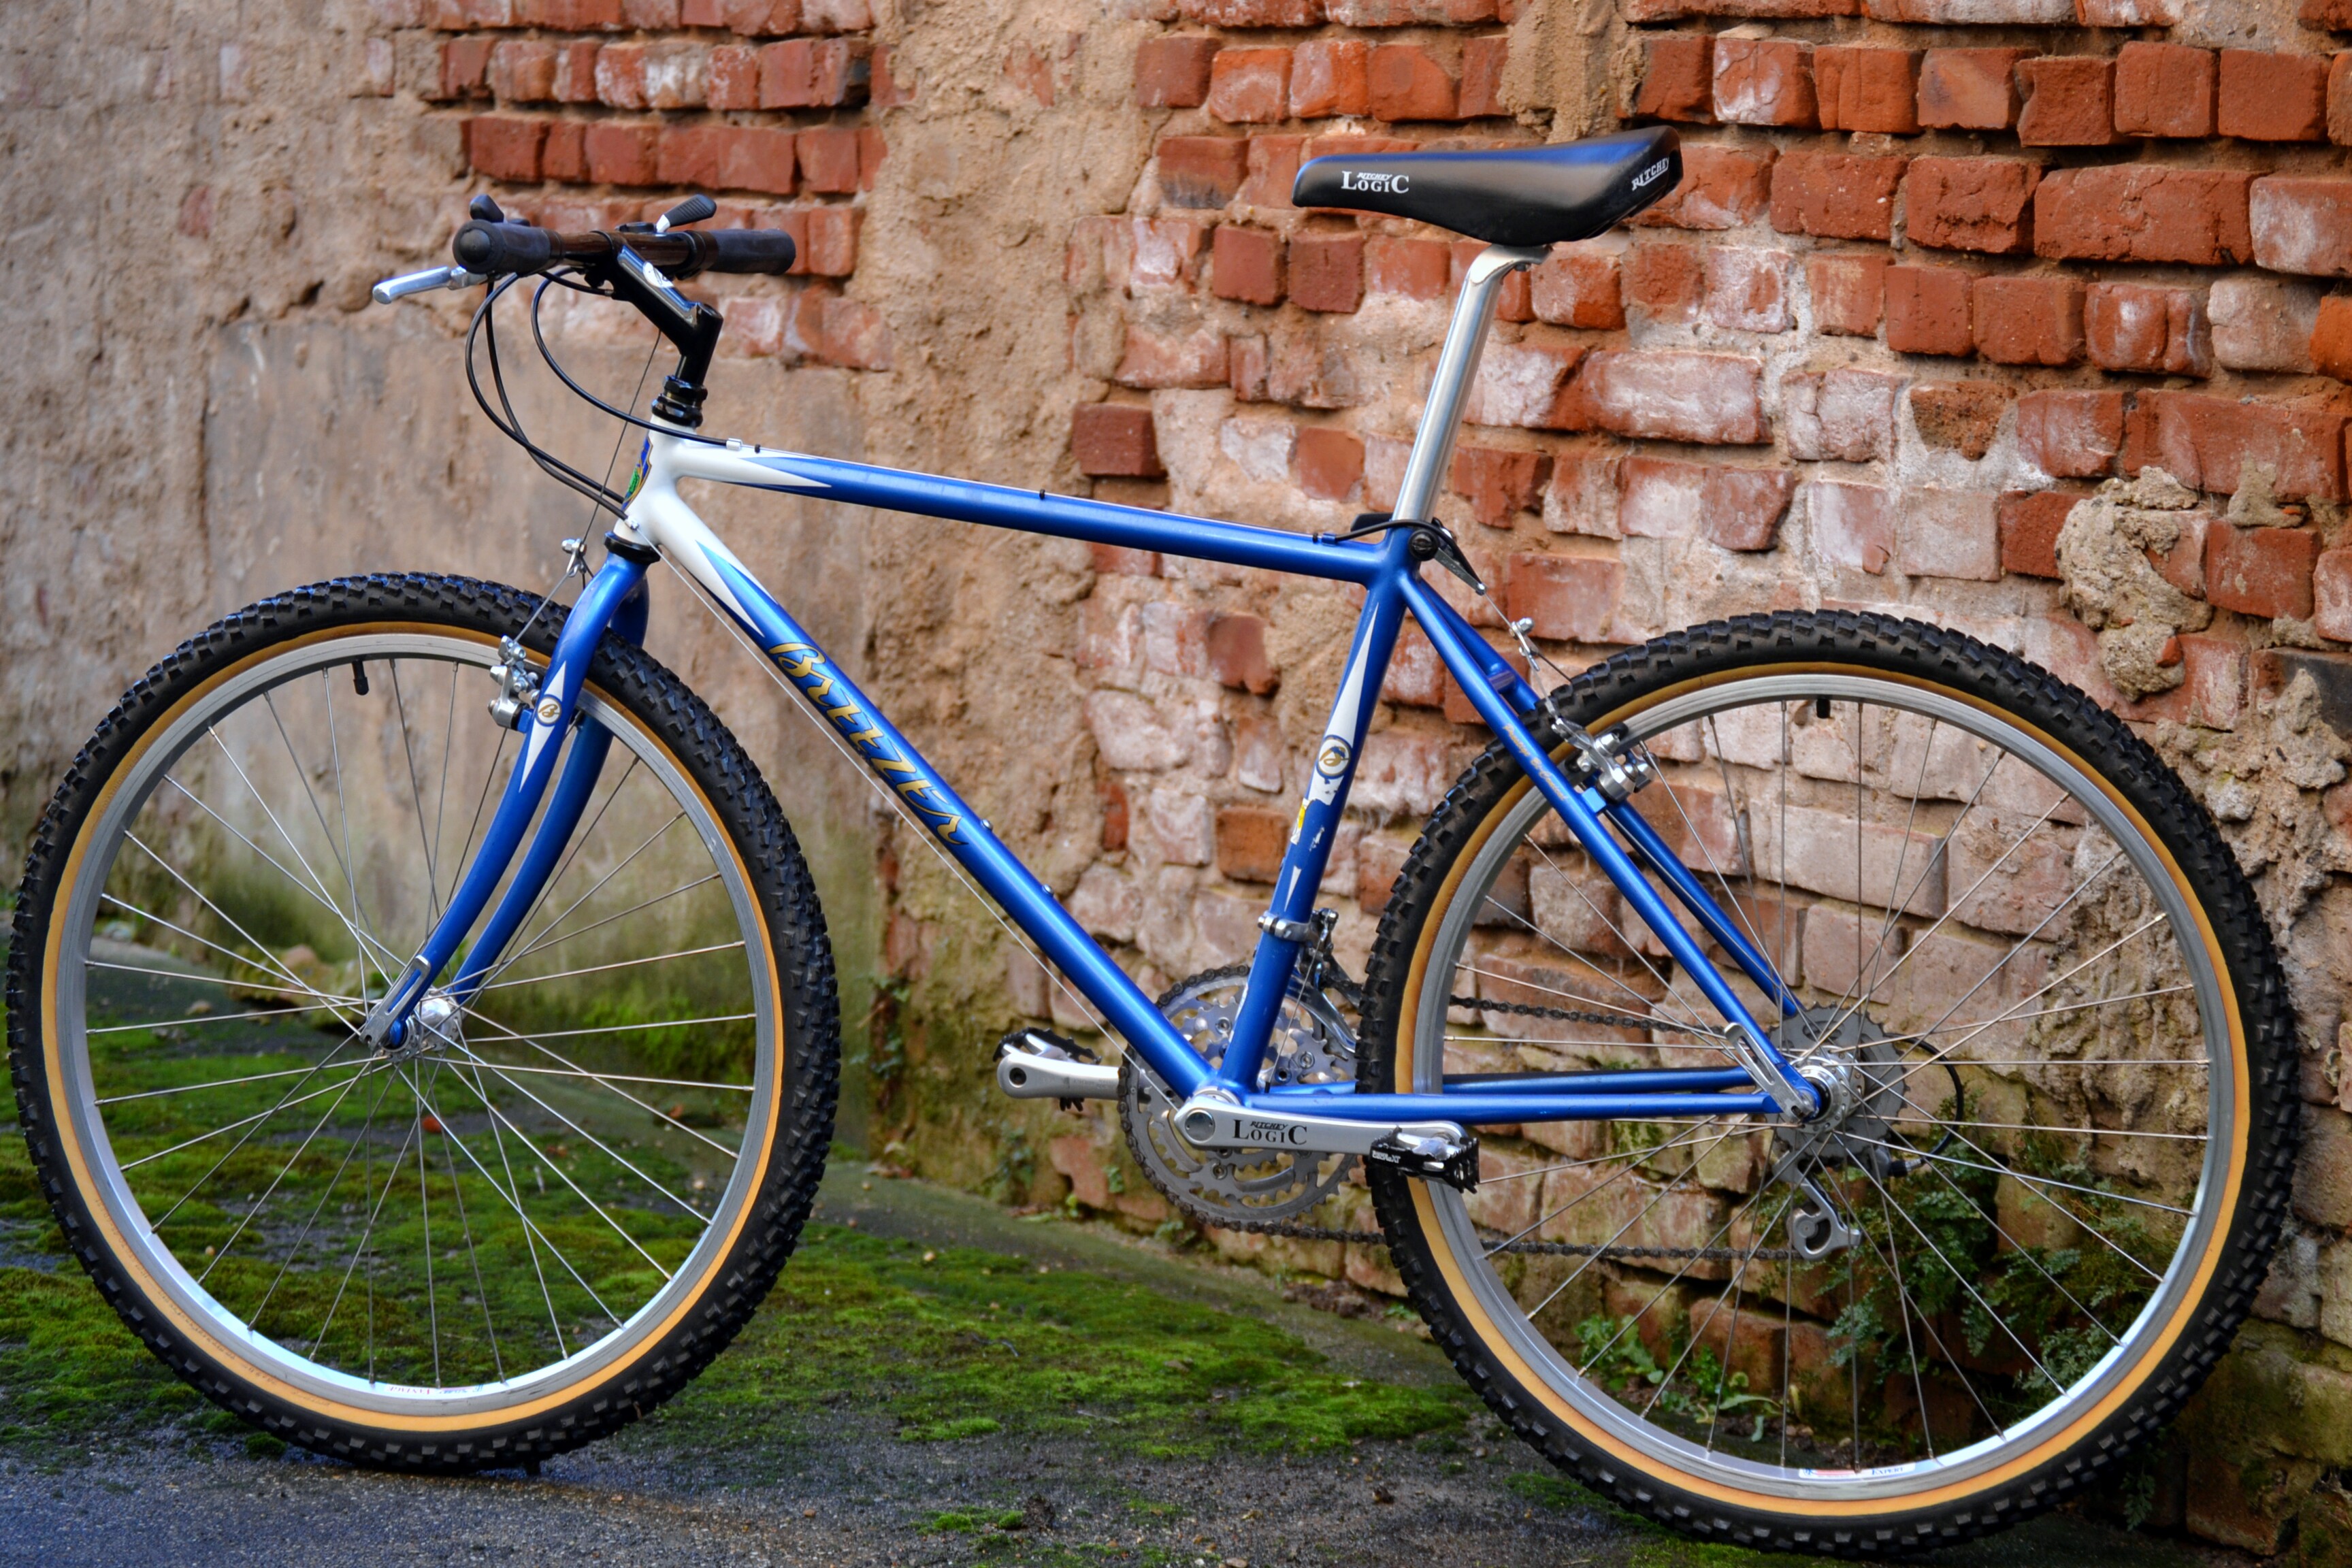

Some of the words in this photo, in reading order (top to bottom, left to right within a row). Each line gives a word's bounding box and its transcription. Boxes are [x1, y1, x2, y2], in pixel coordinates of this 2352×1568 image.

[1341, 170, 1409, 194] LOGIC
[1357, 172, 1393, 182] RITCHEY
[1631, 157, 1670, 192] RITCHEY
[1232, 1120, 1307, 1145] LOGIC
[1250, 1121, 1289, 1131] RITCHEY
